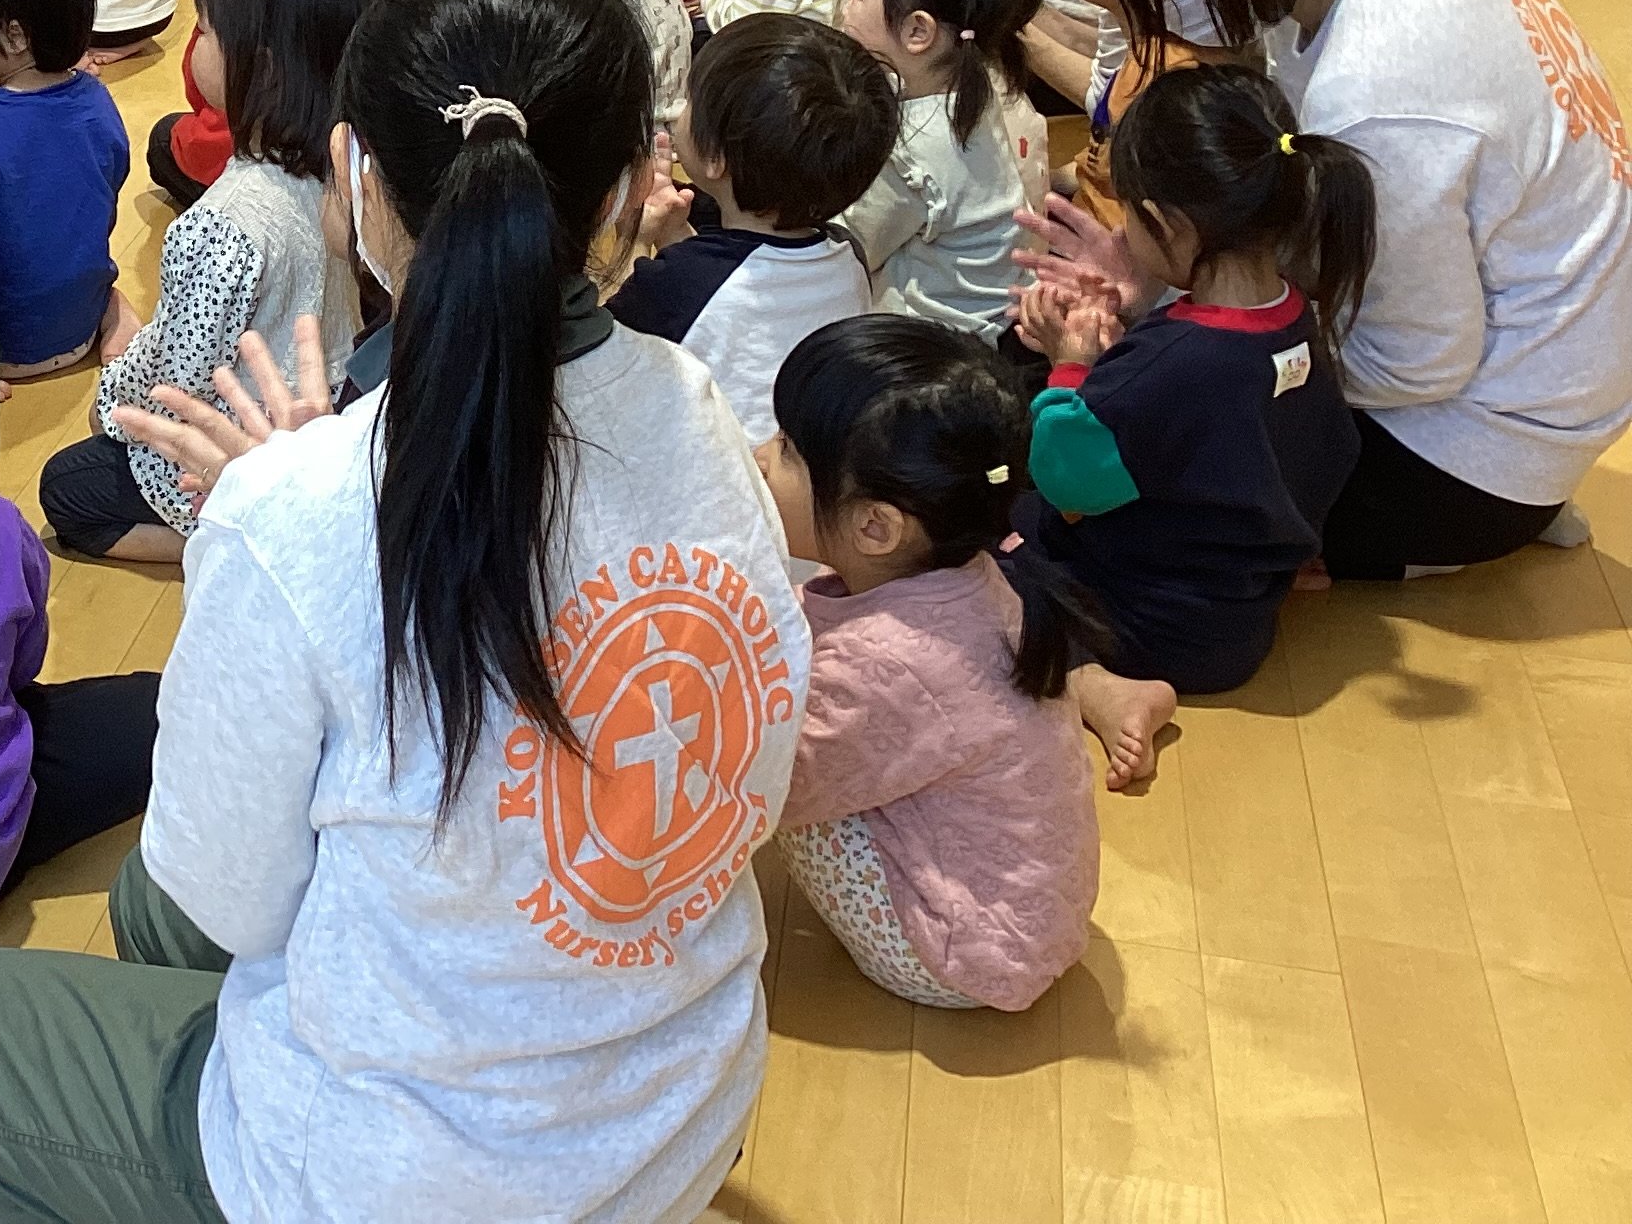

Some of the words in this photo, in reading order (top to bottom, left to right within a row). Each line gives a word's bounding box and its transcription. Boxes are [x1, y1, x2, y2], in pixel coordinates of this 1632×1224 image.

[498, 563, 619, 823] KOSEN
[627, 542, 794, 726] CATHOLIC
[515, 878, 675, 968] Nursery
[667, 792, 770, 940] school
